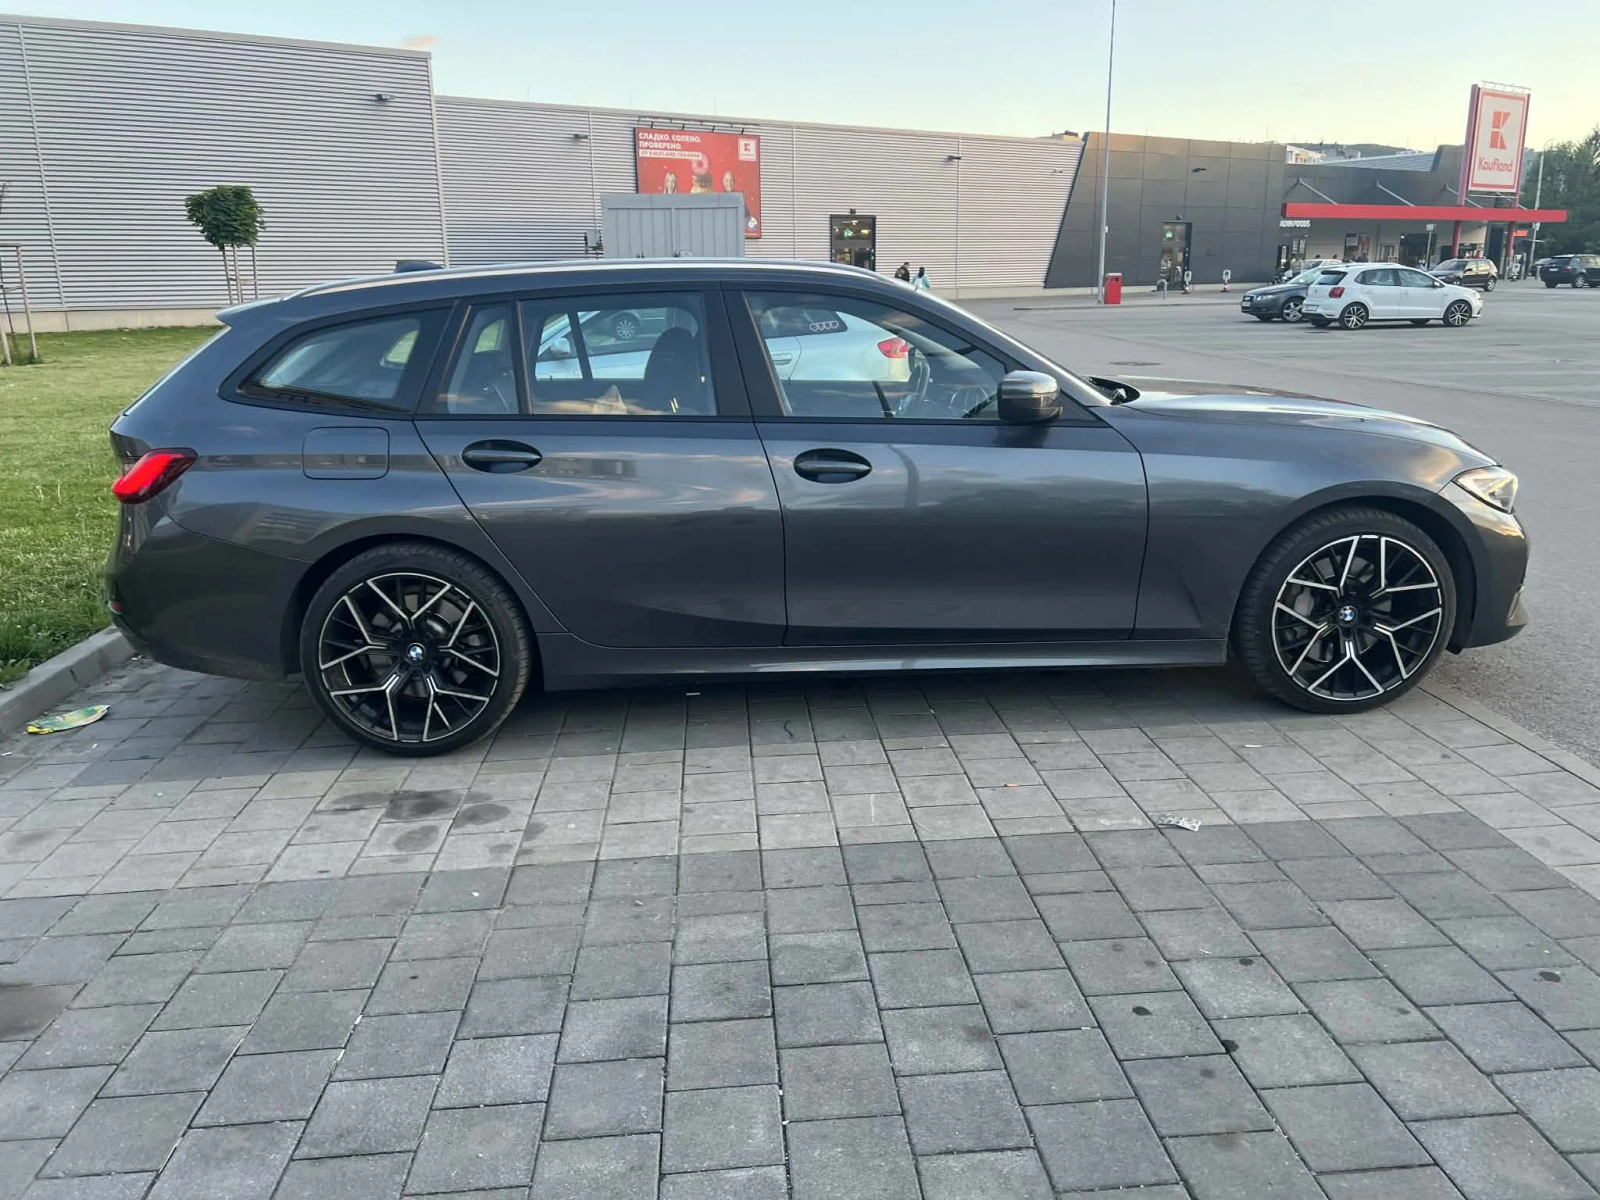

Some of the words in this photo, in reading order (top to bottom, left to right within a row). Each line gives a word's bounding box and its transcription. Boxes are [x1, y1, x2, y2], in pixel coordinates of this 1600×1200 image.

[1489, 110, 1511, 150] K
[638, 132, 670, 141] СЛАДКО.
[671, 134, 701, 143] СОЛЕНО.
[639, 141, 682, 150] ПРОВЕРЕНО.
[1478, 155, 1513, 172] Kaufland
